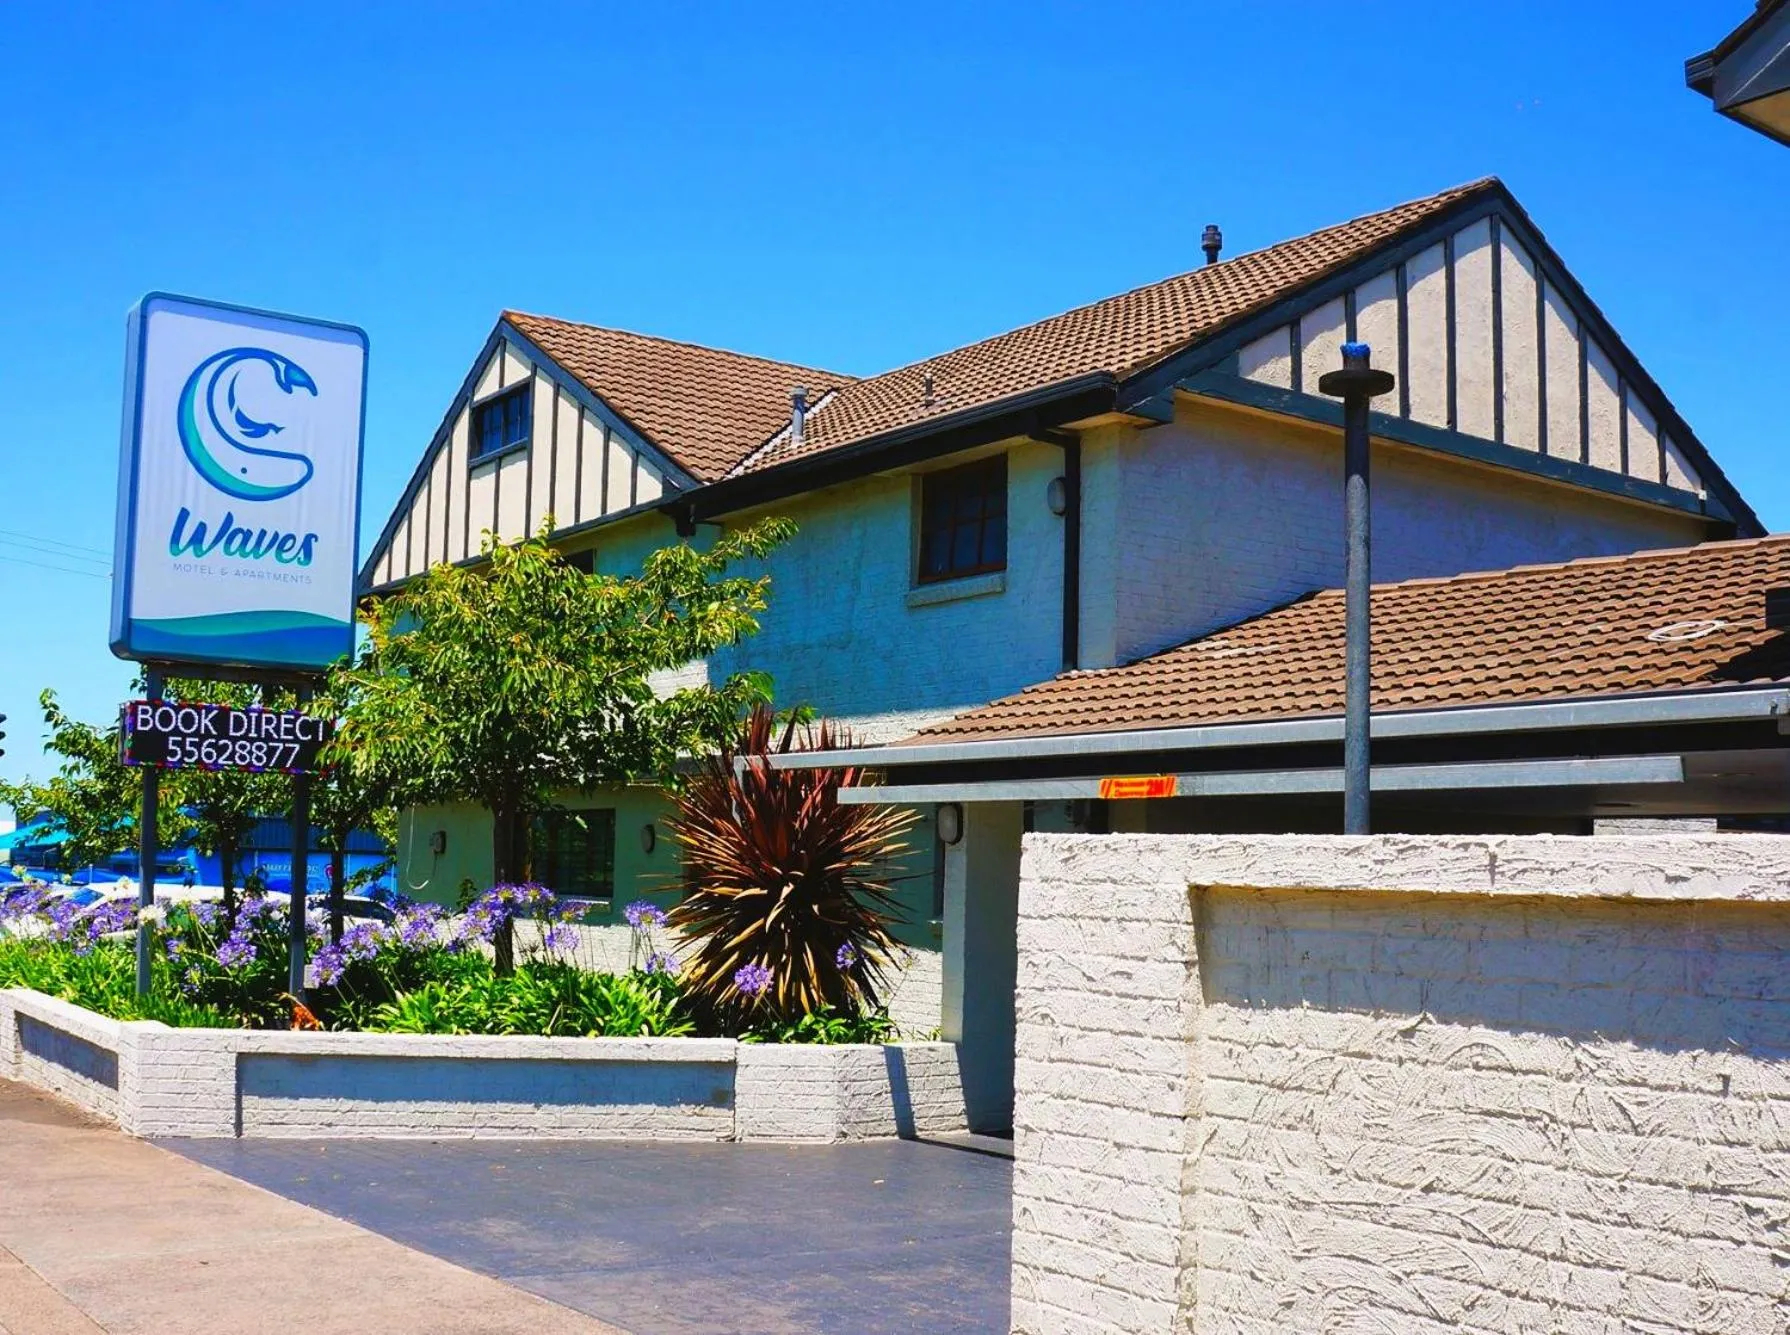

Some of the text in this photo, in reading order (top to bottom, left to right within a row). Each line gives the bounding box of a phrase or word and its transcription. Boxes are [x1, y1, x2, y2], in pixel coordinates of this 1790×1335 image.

[170, 507, 318, 566] Waves
[173, 563, 214, 575] MOTEL
[234, 569, 312, 584] APARTMENTS
[137, 705, 219, 735] BOOK
[167, 737, 300, 767] 55628877
